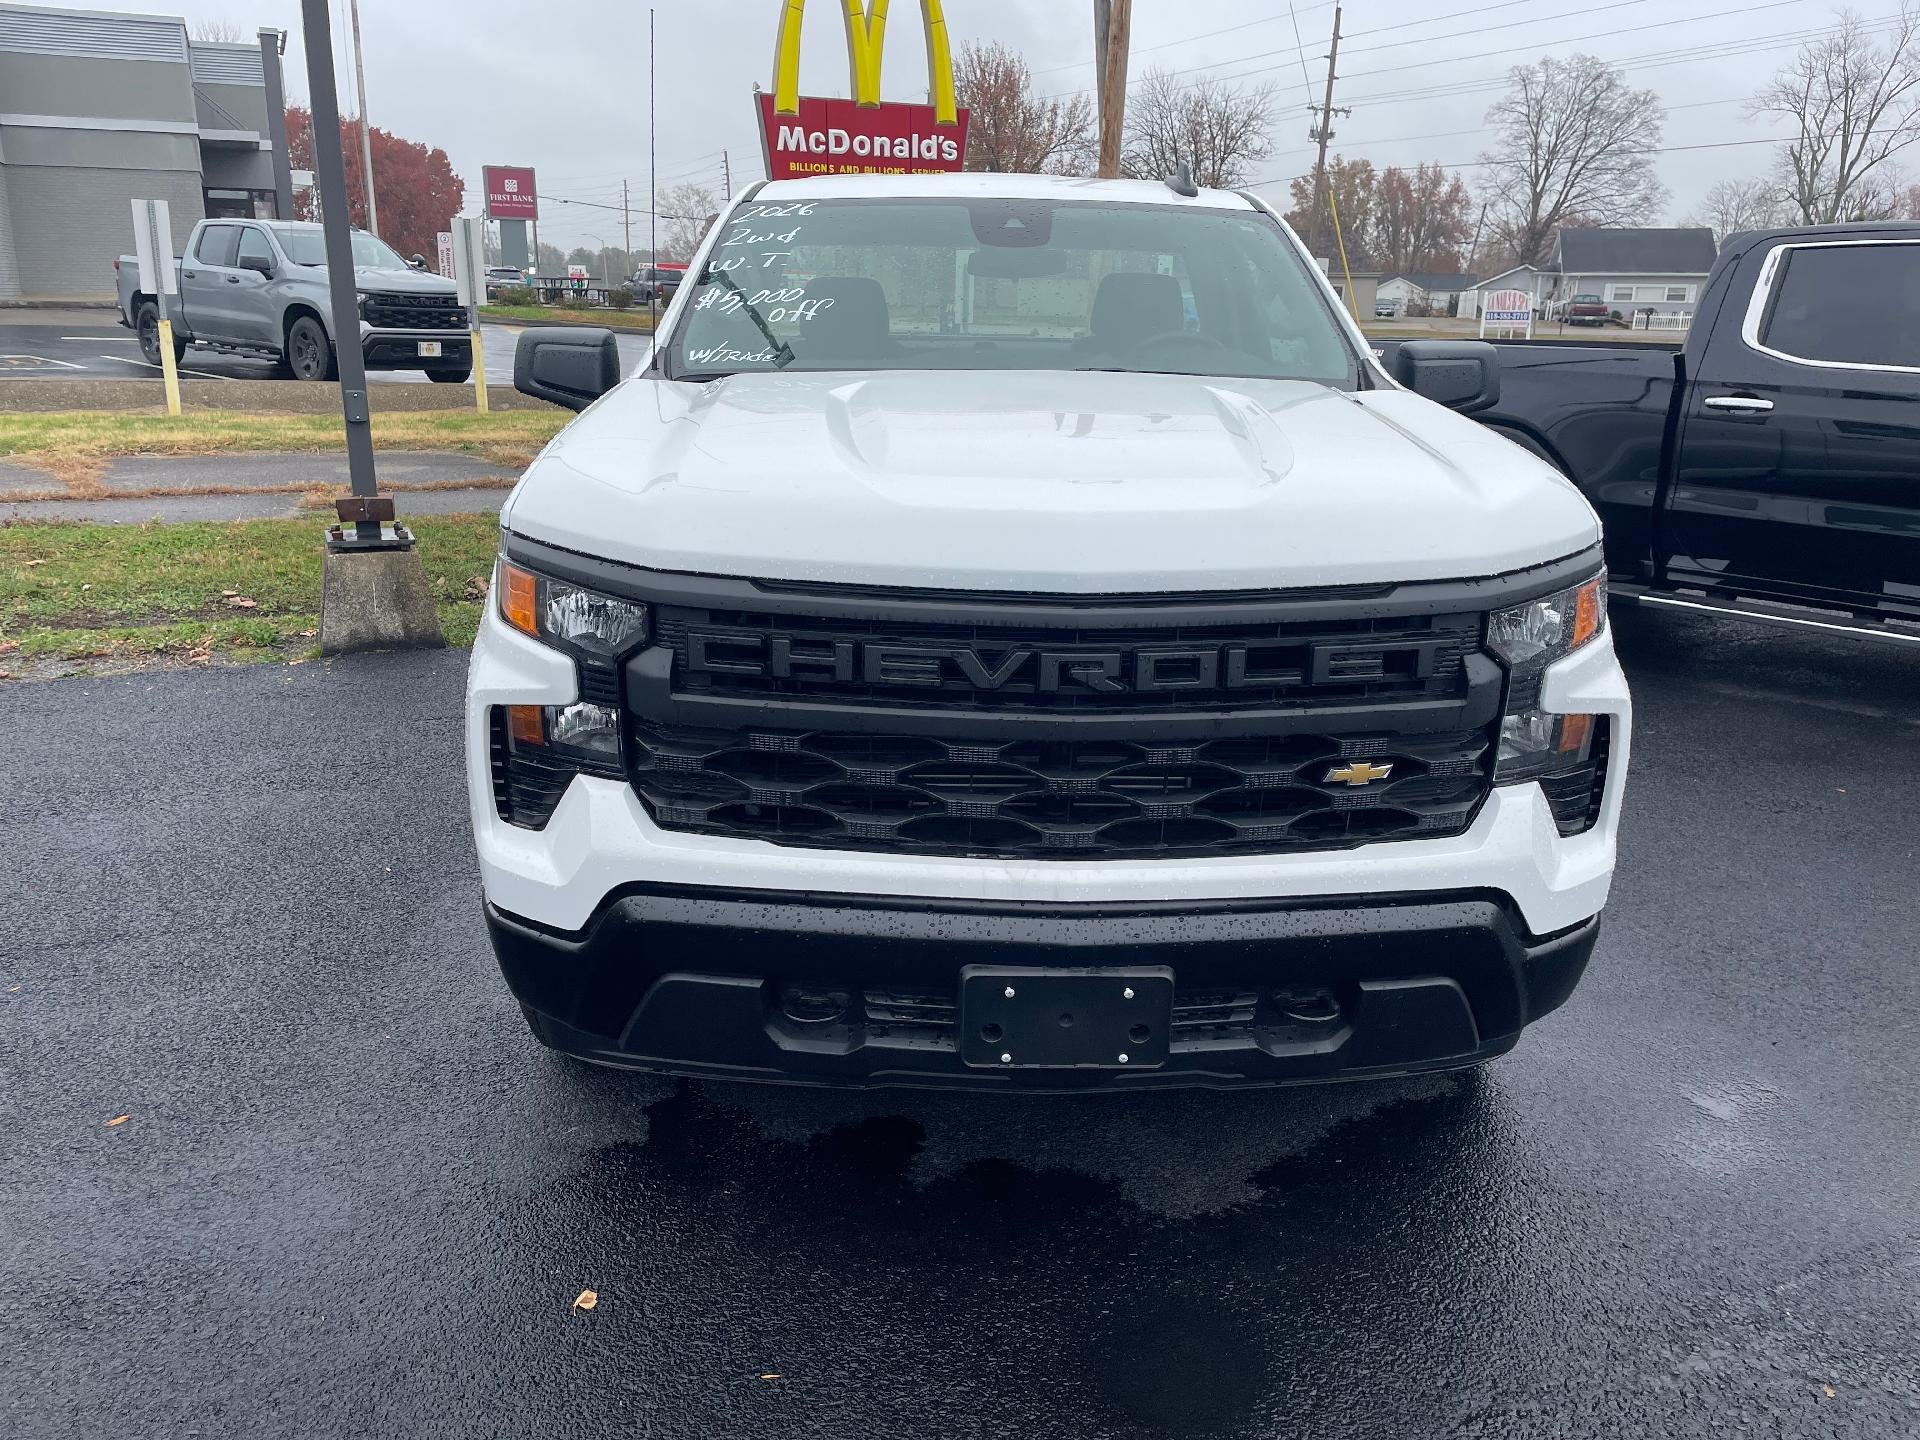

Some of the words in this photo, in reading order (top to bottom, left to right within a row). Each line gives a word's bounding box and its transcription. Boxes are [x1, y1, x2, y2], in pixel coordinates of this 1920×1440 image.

[776, 125, 958, 161] McDonald's
[789, 162, 835, 174] BILLIONS
[839, 164, 860, 174] AND
[864, 166, 905, 175] BILLIONS
[490, 193, 511, 201] FIRST
[512, 194, 534, 202] BANK
[730, 202, 820, 225] 2026
[694, 287, 805, 315] $5,000
[686, 632, 1462, 692] CHEVROLET
